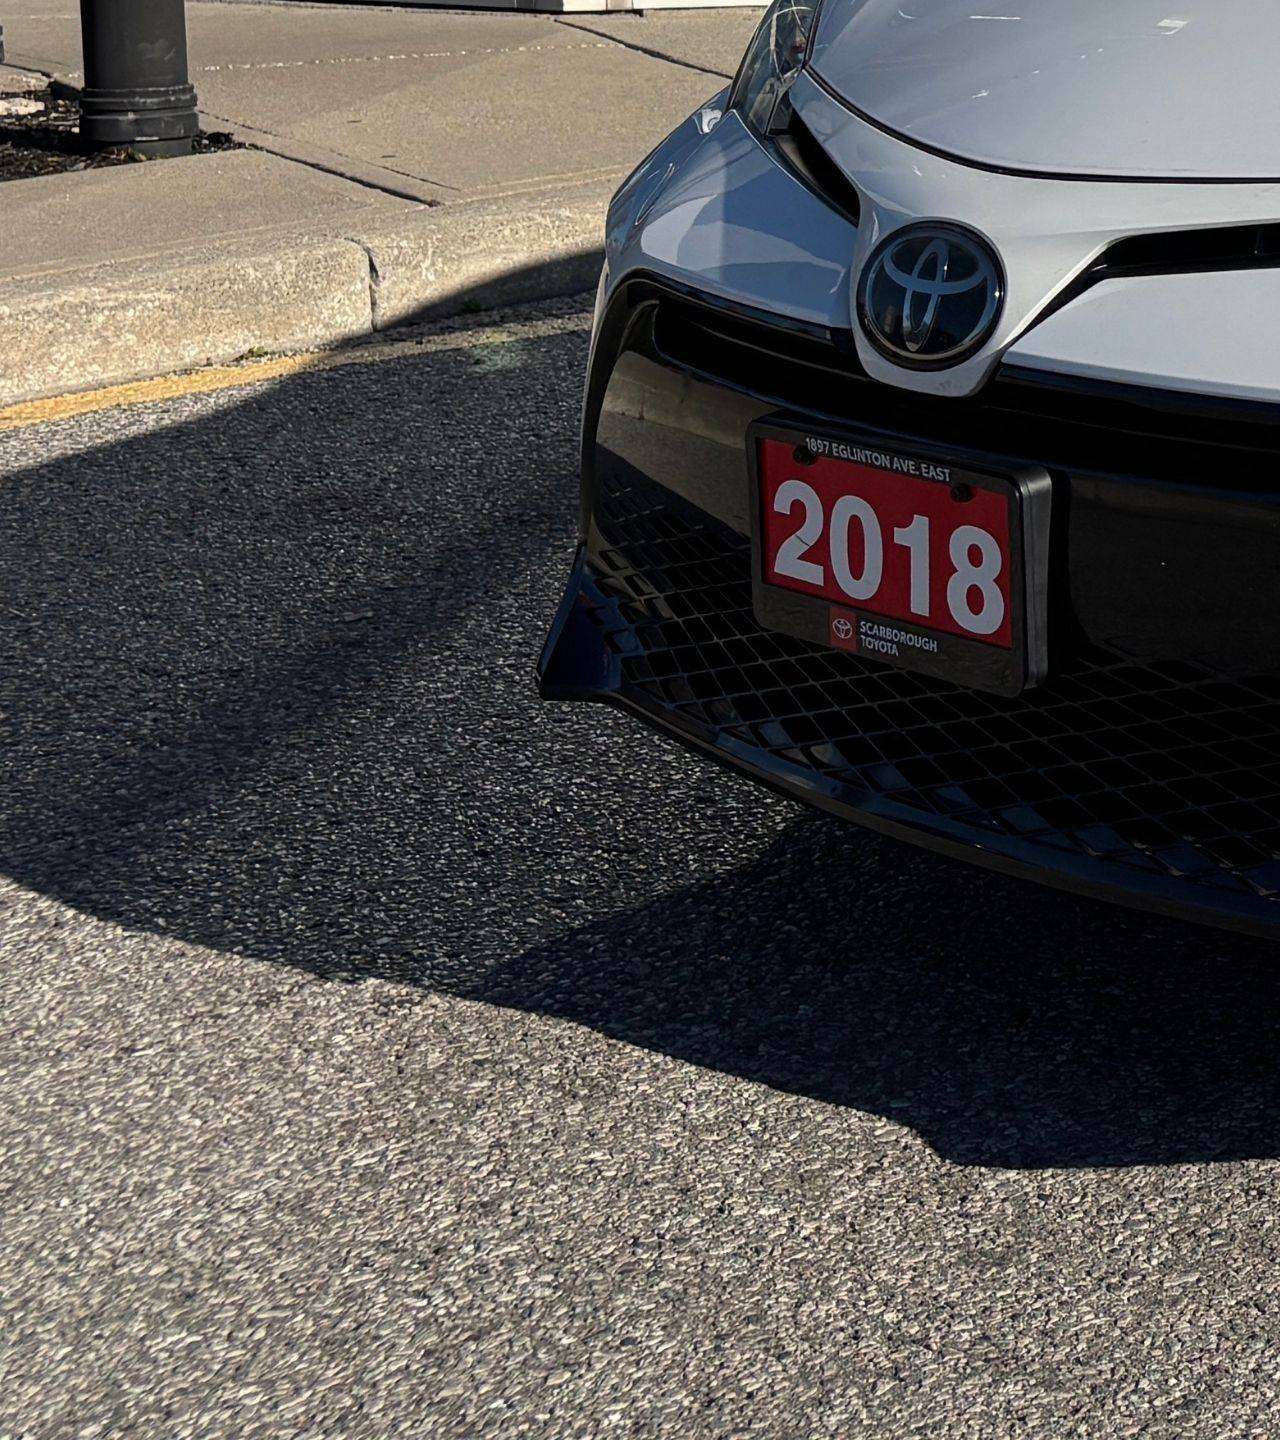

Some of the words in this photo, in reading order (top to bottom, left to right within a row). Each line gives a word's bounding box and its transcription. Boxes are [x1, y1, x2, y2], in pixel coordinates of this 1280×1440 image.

[805, 437, 829, 455] 1897
[832, 442, 891, 469] EGLINTON
[893, 458, 919, 475] AVE.
[921, 464, 950, 482] EAST
[773, 479, 1005, 635] 2018
[860, 620, 937, 652] SCARBOROUGH
[860, 634, 899, 656] TOYOTA
